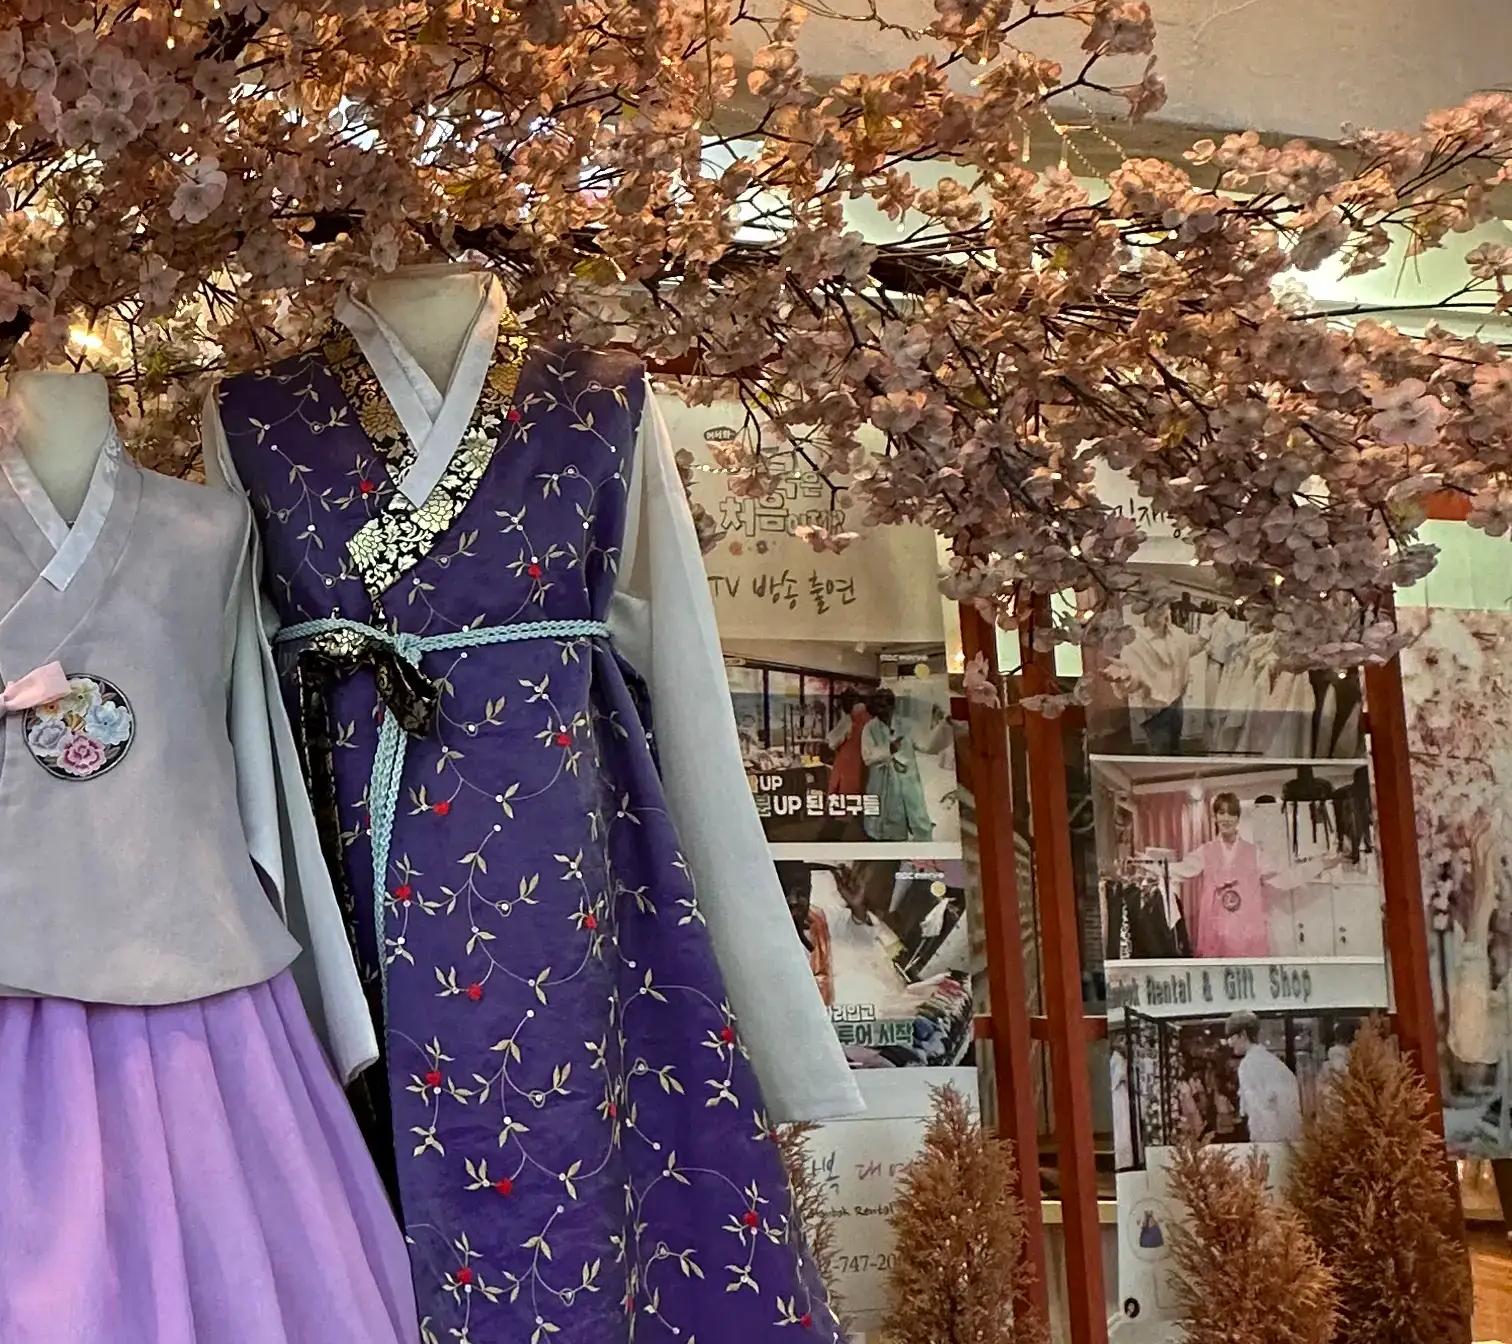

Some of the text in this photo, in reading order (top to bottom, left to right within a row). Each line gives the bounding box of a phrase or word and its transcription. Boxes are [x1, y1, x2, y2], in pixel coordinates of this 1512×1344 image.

[707, 568, 857, 615] TV 방송 출연
[828, 793, 880, 816] 친구들
[1146, 971, 1192, 1006] Rental
[1224, 966, 1256, 1001] Gift
[1269, 964, 1312, 1003] Shop
